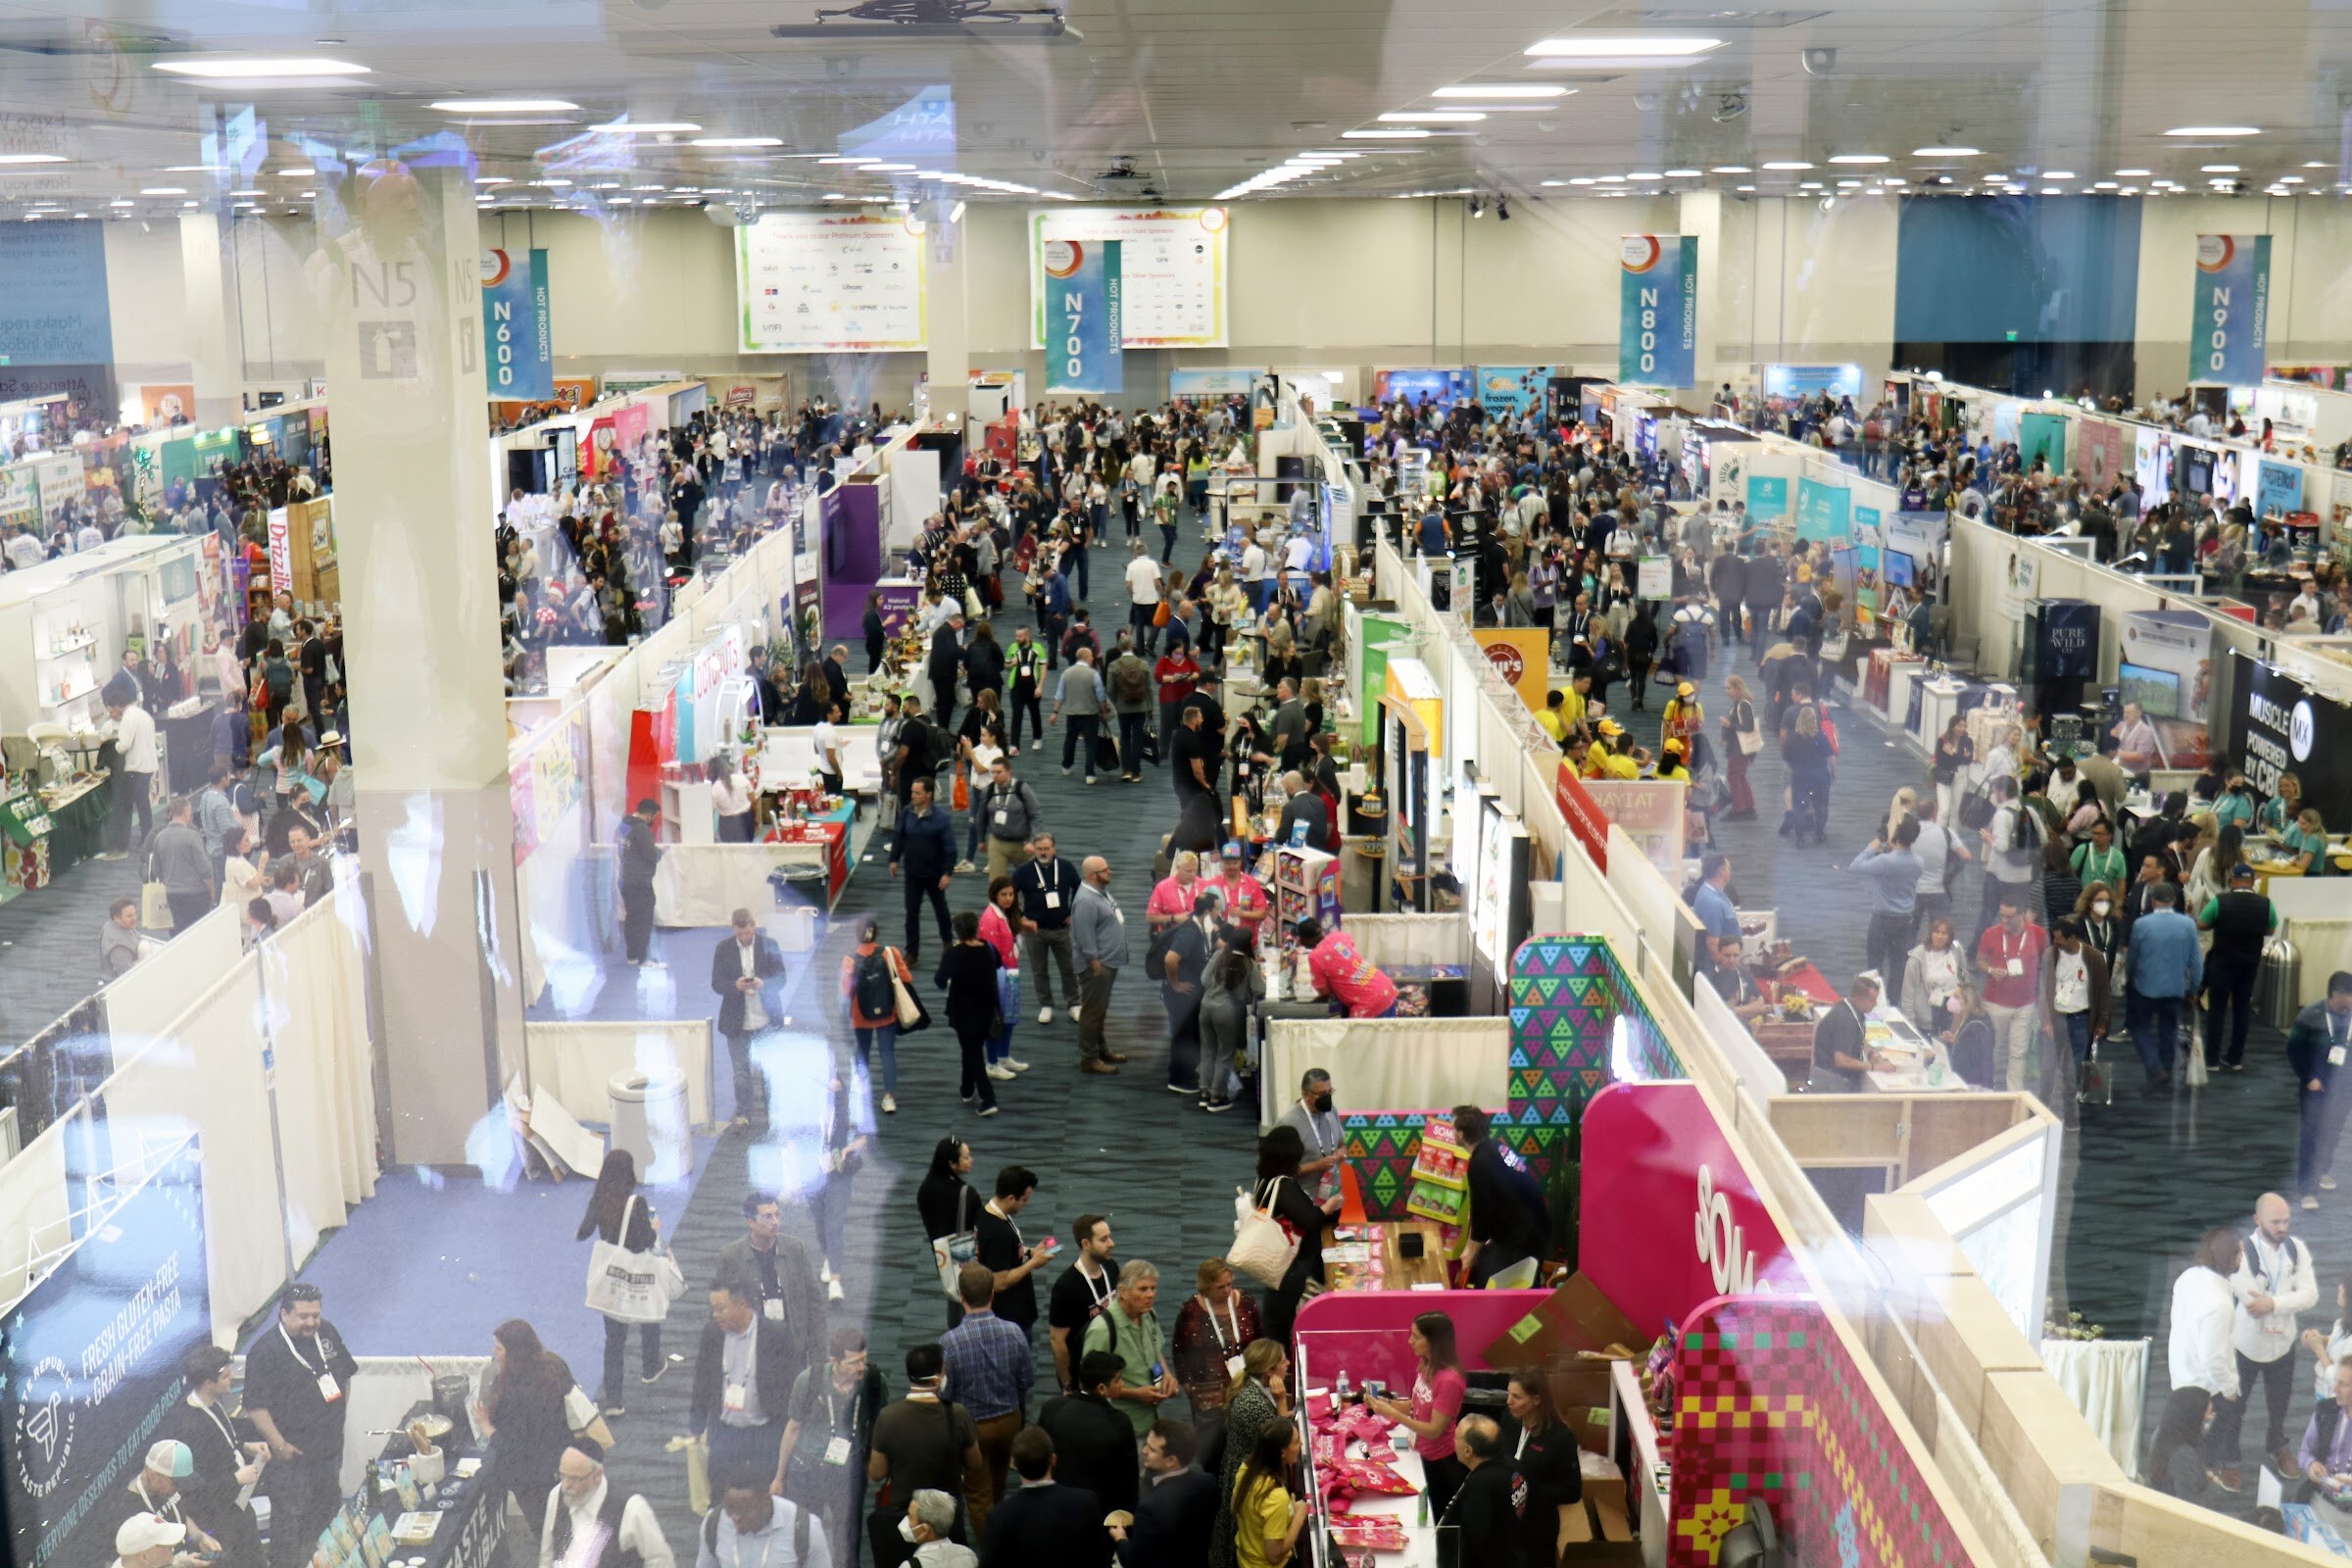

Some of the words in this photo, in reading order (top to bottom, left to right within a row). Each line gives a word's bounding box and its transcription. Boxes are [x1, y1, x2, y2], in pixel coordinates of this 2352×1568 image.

[350, 261, 416, 309] N5
[453, 258, 473, 307] N5
[536, 286, 546, 311] HOT
[1109, 278, 1118, 298] HOT
[1685, 274, 1693, 294] HOT
[493, 302, 514, 385] N600
[538, 312, 550, 363] PRODUCTS
[1065, 293, 1083, 377] N700
[1108, 301, 1118, 355] PRODUCTS
[1640, 287, 1658, 373] N800
[1683, 297, 1693, 350] PRODUCTS
[2210, 287, 2230, 371] N900
[2253, 296, 2265, 349] PRODUCTS
[1485, 394, 1518, 403] frozen,
[1486, 405, 1515, 415] vegn
[2050, 637, 2086, 648] WILD
[2052, 627, 2085, 638] PURE
[2248, 692, 2290, 737] MUSCLE
[2292, 715, 2309, 748] MX
[2244, 755, 2257, 777] BY
[2246, 729, 2287, 769] POWERED
[1694, 1163, 1772, 1295] SOM
[81, 1320, 117, 1380] FRESH
[117, 1250, 180, 1342] GLUTEN-FREE
[93, 1316, 153, 1406] GRAIN-FREE
[152, 1286, 182, 1338] PASTA
[15, 1378, 34, 1445] TASTE
[33, 1355, 74, 1390] REPUBLIC
[19, 1463, 44, 1498] TASTE
[45, 1411, 75, 1495] REPUBLIC
[35, 1503, 79, 1568] EVERYONE
[77, 1459, 119, 1519] DESERVES
[117, 1448, 128, 1474] TO
[127, 1432, 141, 1459] EAT
[141, 1409, 161, 1444] GOOD
[161, 1377, 183, 1418] PASTA
